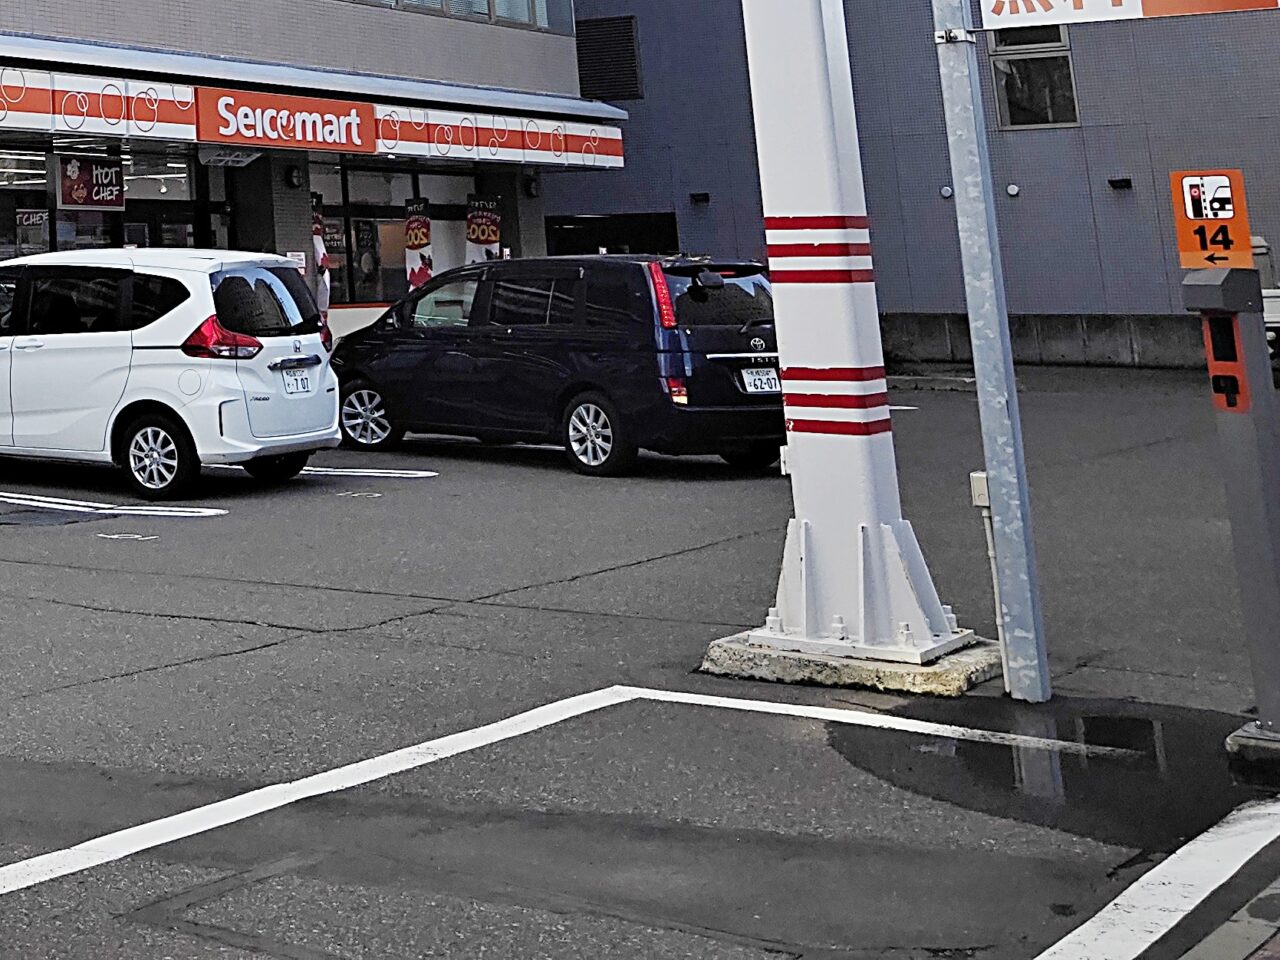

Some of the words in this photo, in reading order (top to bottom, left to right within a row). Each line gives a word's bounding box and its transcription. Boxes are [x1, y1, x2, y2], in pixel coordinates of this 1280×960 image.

[217, 96, 362, 145] Seicomart
[92, 165, 120, 184] HOT
[92, 186, 120, 200] CHEF
[1193, 224, 1234, 251] 14
